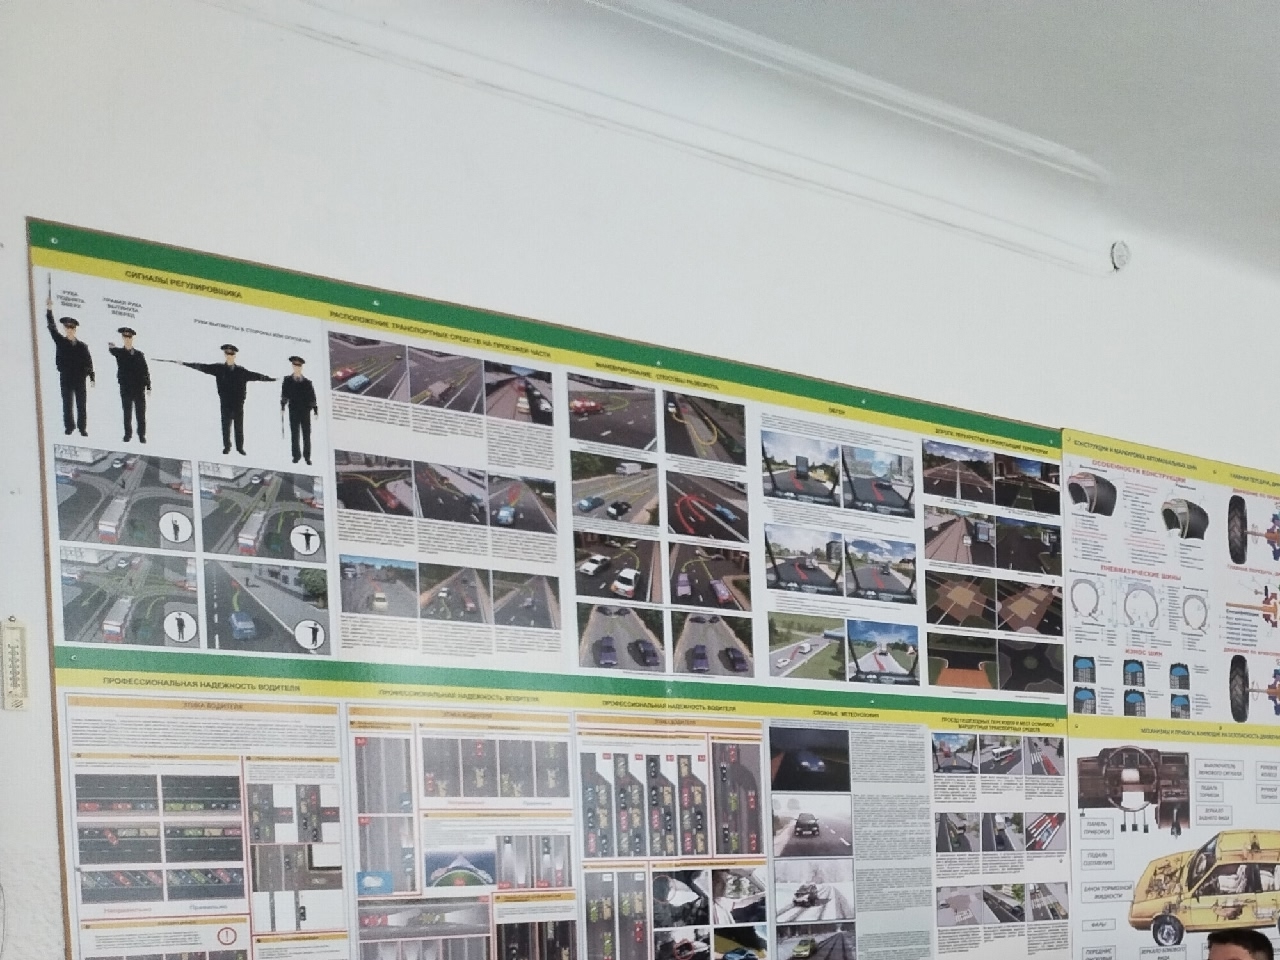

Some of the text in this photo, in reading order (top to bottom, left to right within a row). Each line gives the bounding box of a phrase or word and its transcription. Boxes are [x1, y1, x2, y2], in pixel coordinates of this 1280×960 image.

[125, 270, 243, 298] СИГНАЛЫ РЕГУЛИРОВЩИКА
[329, 311, 390, 329] РАСПОЛОЖЕНИЕ
[1092, 459, 1141, 475] ОСОБЕННОСТИ
[1100, 564, 1182, 581] ПНЕВМАТИЧЕСКИЕ ШИНЫ
[103, 677, 301, 692] ПРОФЕССИОНАЛЬНАЯ НАДЕЖНОСТЬ ВОДИТЕЛЯ
[378, 689, 539, 703] ПРОФЕССИОНАЛЬНАЯ НАДЕЖНОСТЬ ВОДИТЕЛЯ
[602, 700, 737, 712] ПРОФЕССИОНАЛЬНАЯ НАДЕЖНОСТЬ ВОДИТЕЛЯ
